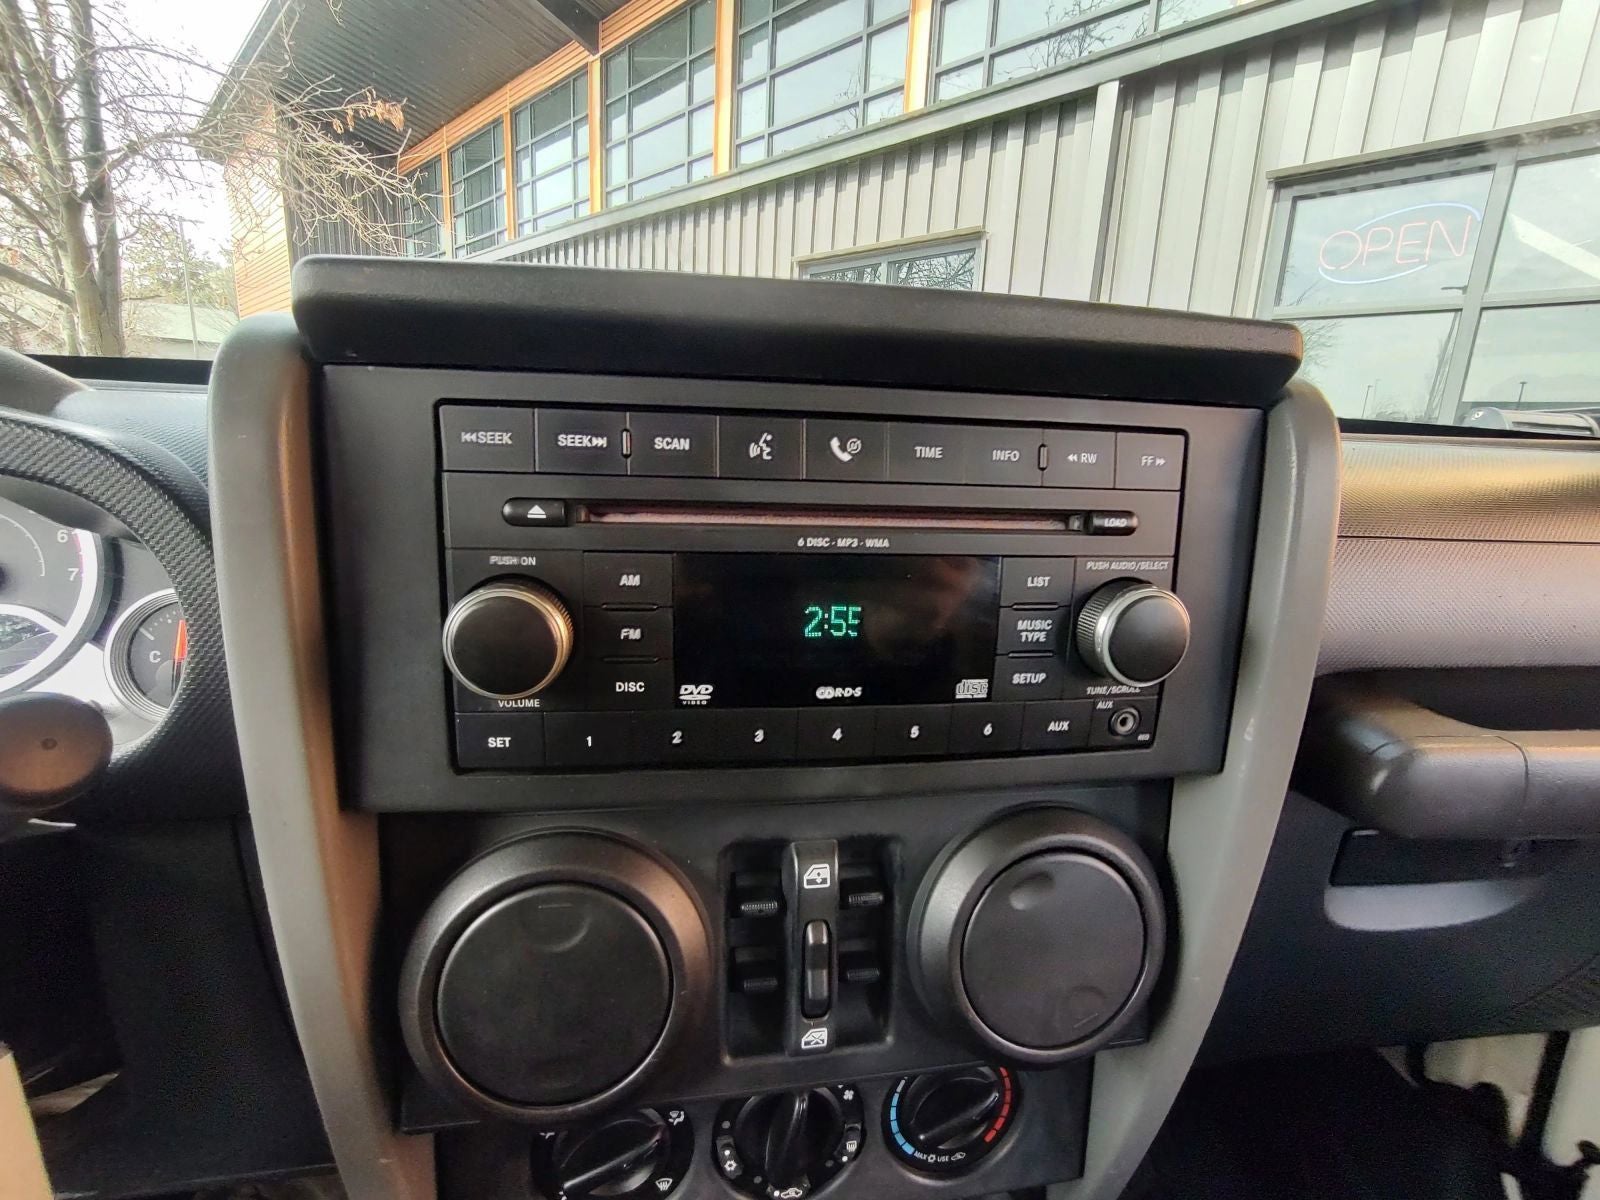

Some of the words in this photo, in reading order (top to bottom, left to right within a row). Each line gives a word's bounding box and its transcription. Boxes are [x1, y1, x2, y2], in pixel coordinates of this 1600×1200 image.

[1319, 215, 1472, 270] OPEN
[478, 431, 512, 445] SEEK
[558, 433, 593, 448] SEEK
[654, 436, 690, 451] SCAN
[914, 446, 943, 459] TIME
[992, 449, 1020, 462] INFO
[1080, 452, 1097, 464] RW
[1141, 455, 1154, 466] FF
[1103, 517, 1128, 528] LOAD
[57, 529, 68, 543] 6
[798, 537, 804, 547] 6
[807, 537, 830, 547] DISC
[837, 537, 858, 548] MP3
[865, 538, 890, 548] WMA
[489, 555, 520, 566] PUSH
[520, 556, 536, 566] ON
[1086, 560, 1110, 571] PUSH
[68, 568, 79, 581] 7
[619, 574, 641, 586] AM
[1027, 576, 1051, 587] LIST
[804, 606, 862, 638] 2:55
[1017, 619, 1053, 631] MUSIC
[620, 628, 641, 640] FM
[1019, 631, 1047, 643] TYPE
[149, 650, 161, 664] C
[1012, 672, 1047, 685] SETUP
[616, 681, 644, 693] DISC
[679, 684, 714, 695] DVD
[498, 698, 541, 708] VOLUME
[1096, 700, 1114, 710] AUX
[910, 725, 920, 739] 5
[984, 723, 992, 736] 6
[1047, 720, 1070, 732] AUX
[671, 730, 682, 744] 2
[754, 729, 764, 743] 3
[831, 727, 843, 741] 4
[487, 736, 512, 748] SET
[586, 735, 592, 747] 1
[914, 1150, 928, 1161] MAX
